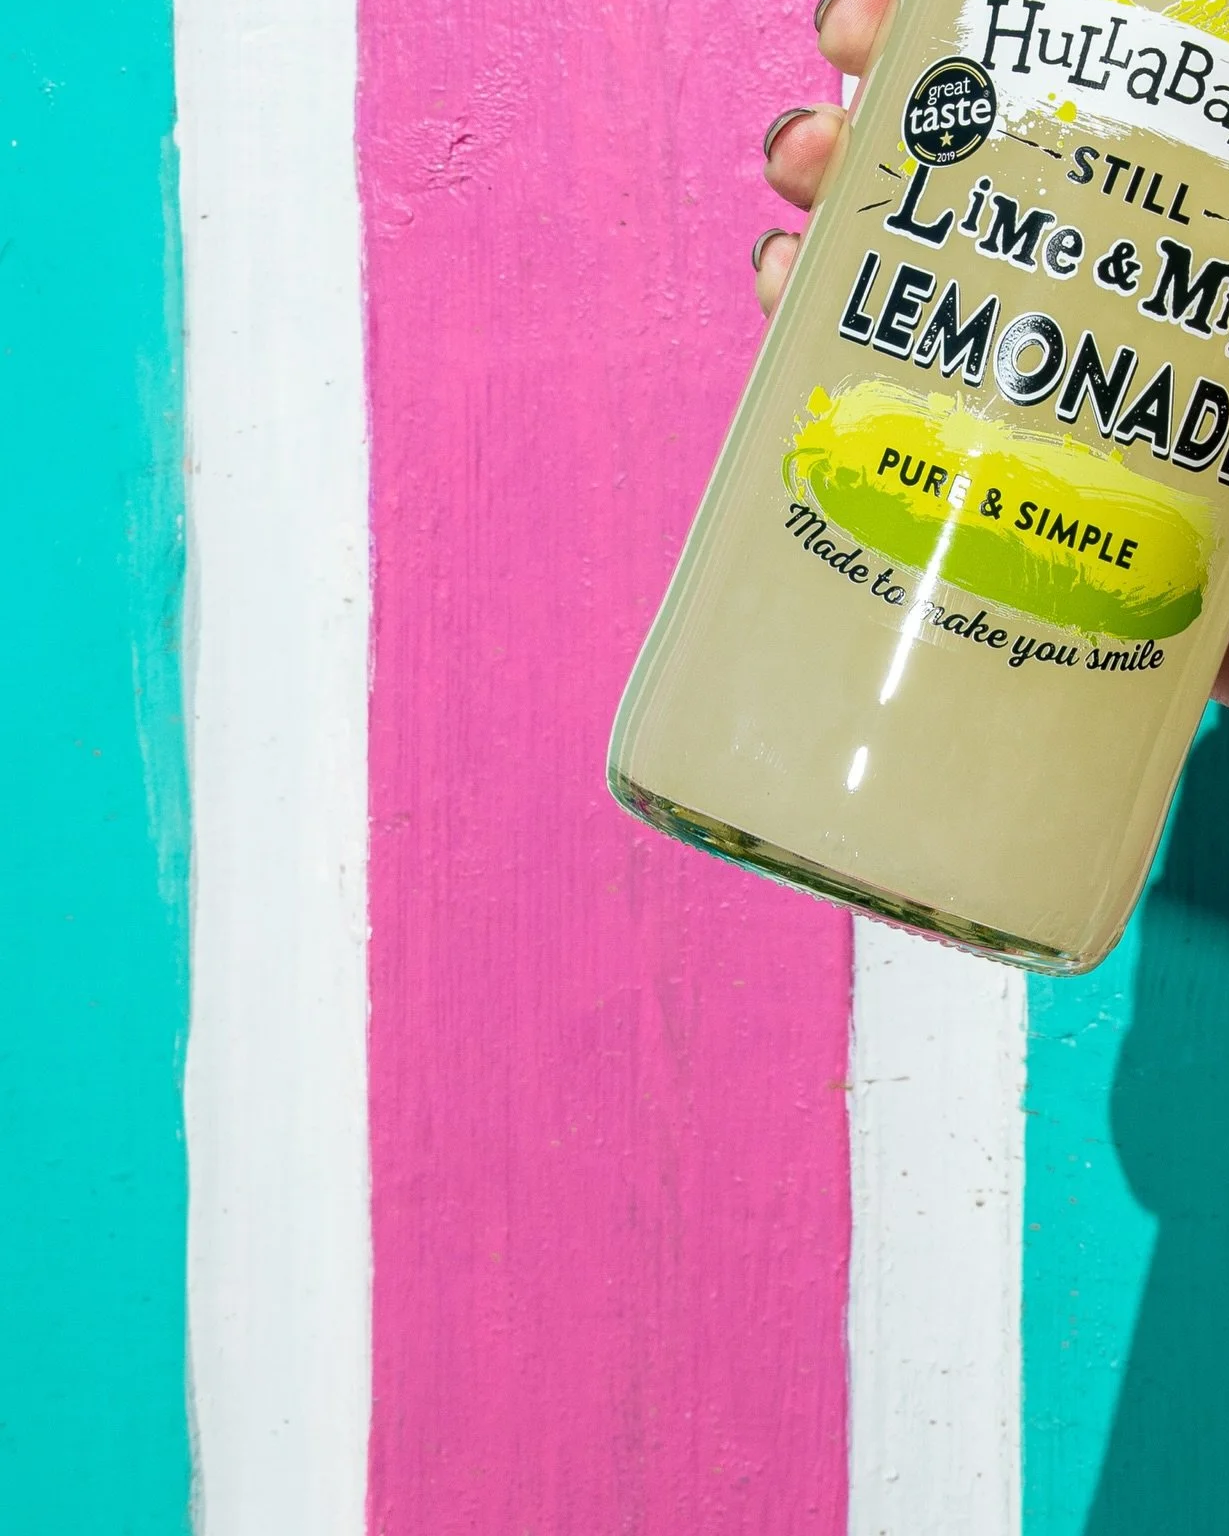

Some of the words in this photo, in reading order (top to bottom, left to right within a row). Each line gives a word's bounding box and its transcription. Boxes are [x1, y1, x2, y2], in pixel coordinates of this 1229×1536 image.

[909, 97, 992, 135] taste
[927, 76, 971, 105] great
[936, 151, 956, 163] 2019
[1067, 146, 1191, 226] STILL
[1096, 240, 1142, 293] &
[876, 447, 972, 509] PURE
[979, 487, 1003, 520] &
[1014, 501, 1139, 570] SIMPLE
[784, 503, 869, 584] Made
[870, 568, 907, 606] to
[909, 599, 1009, 649] make
[1008, 635, 1080, 668] you
[1085, 639, 1165, 672] smile
